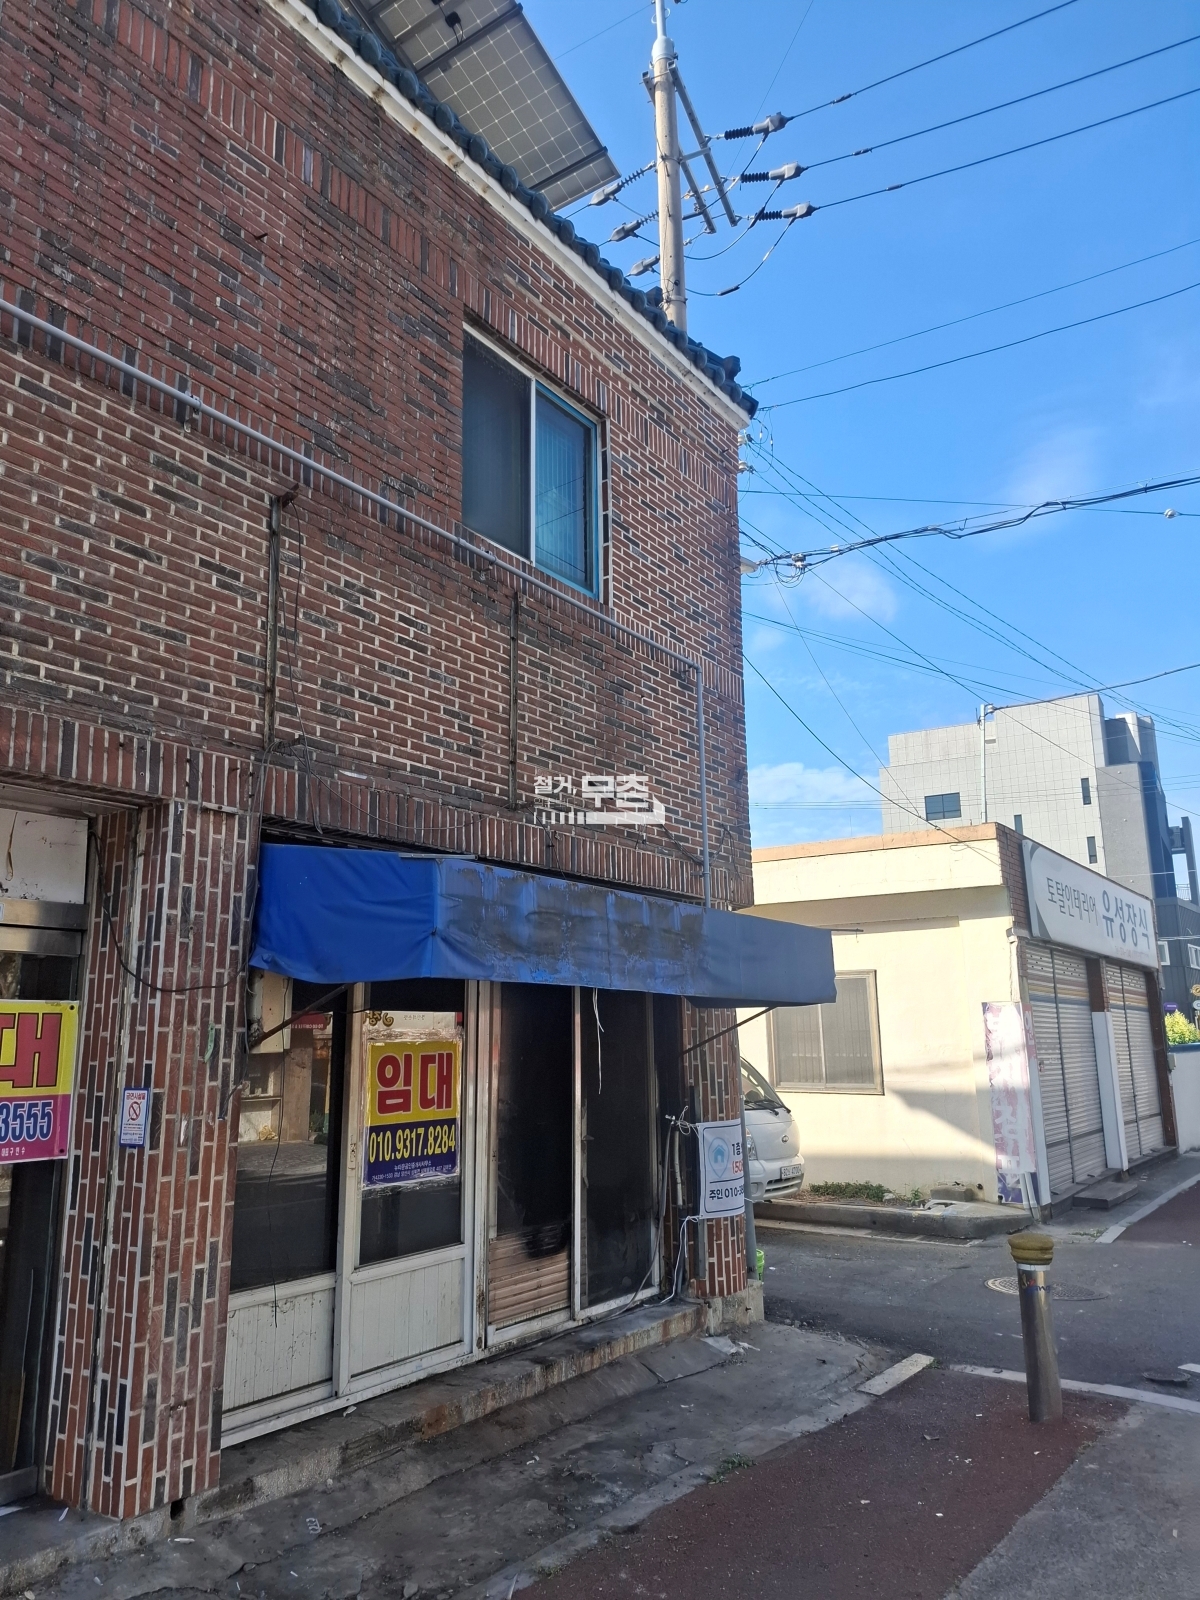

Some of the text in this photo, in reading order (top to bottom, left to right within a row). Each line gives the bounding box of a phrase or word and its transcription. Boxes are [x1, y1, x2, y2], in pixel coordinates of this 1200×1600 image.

[1045, 877, 1150, 950] 토탈인테리어 유성장식
[376, 1051, 454, 1116] 임대
[369, 1124, 456, 1163] 010.9317.8284
[709, 1189, 723, 1201] 주인
